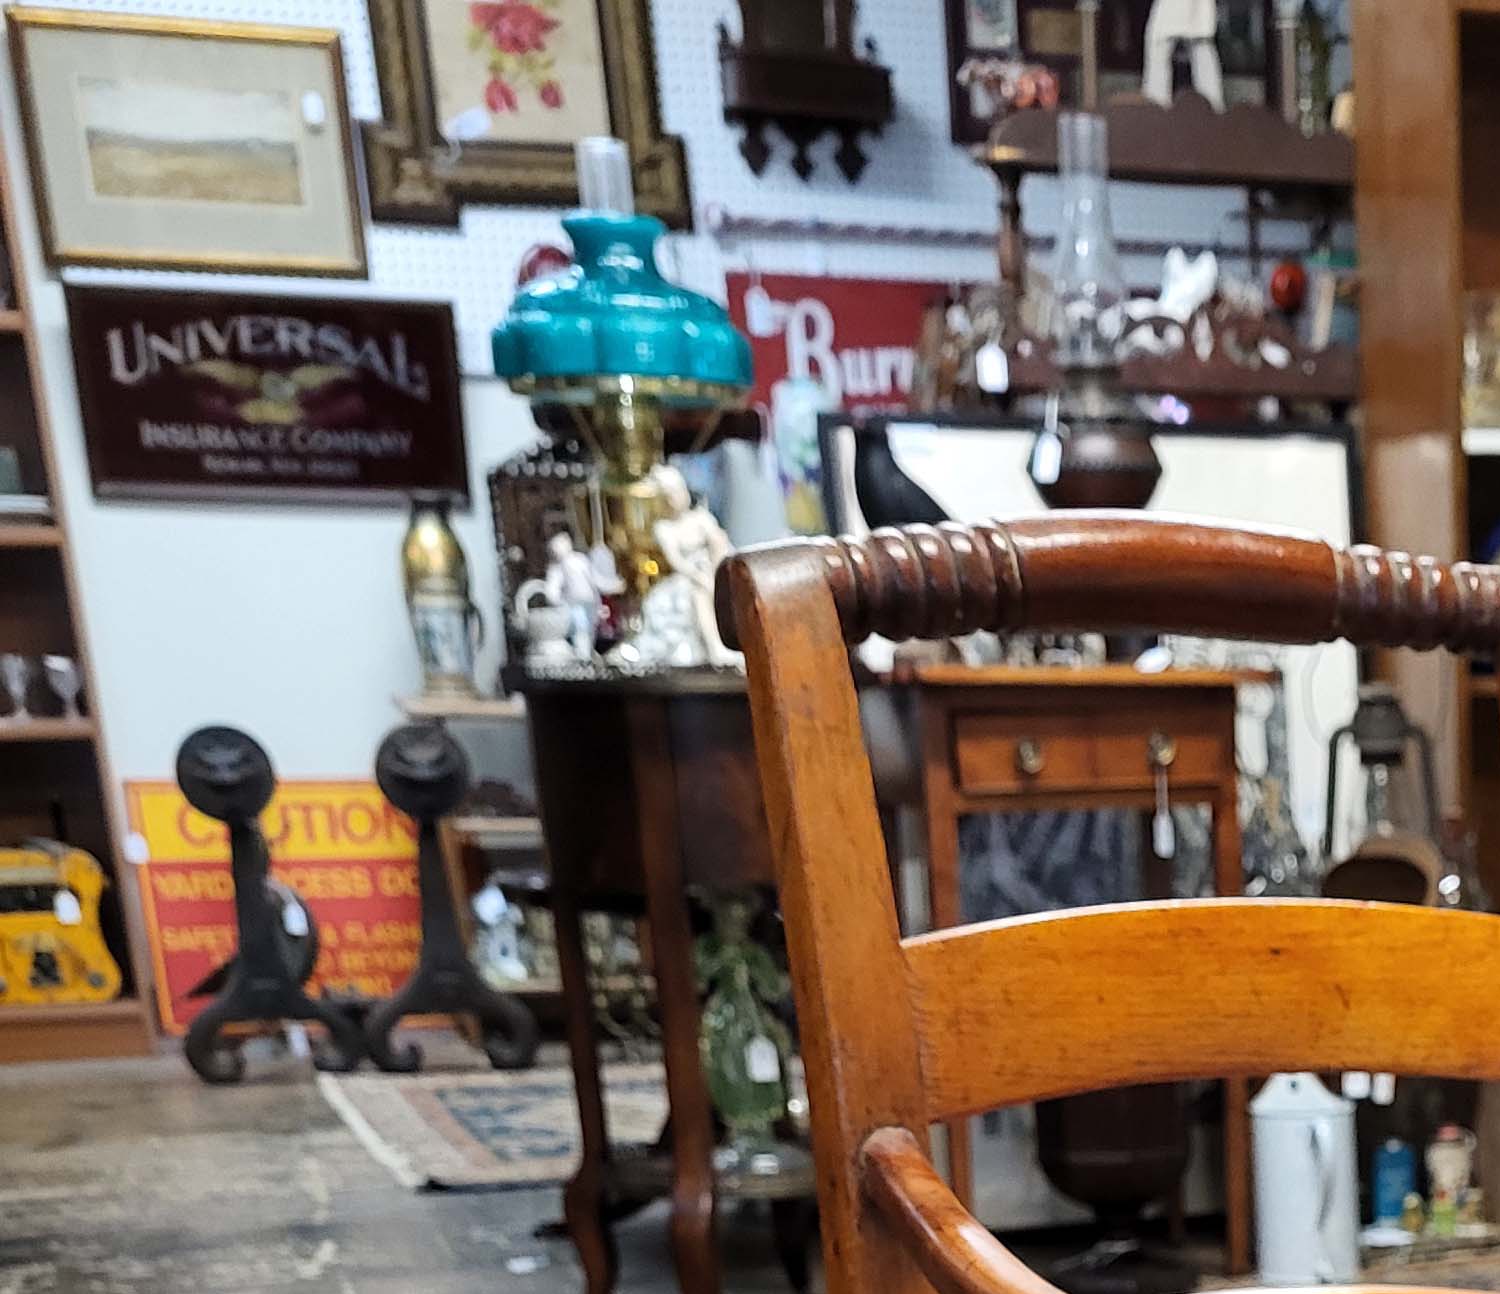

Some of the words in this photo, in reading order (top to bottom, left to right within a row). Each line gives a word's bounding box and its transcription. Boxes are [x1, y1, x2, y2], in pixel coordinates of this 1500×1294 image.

[105, 314, 431, 399] UNIVERSAL
[138, 419, 282, 450] INSURANCE
[290, 425, 413, 457] COMPANY
[176, 801, 418, 848] CUTION
